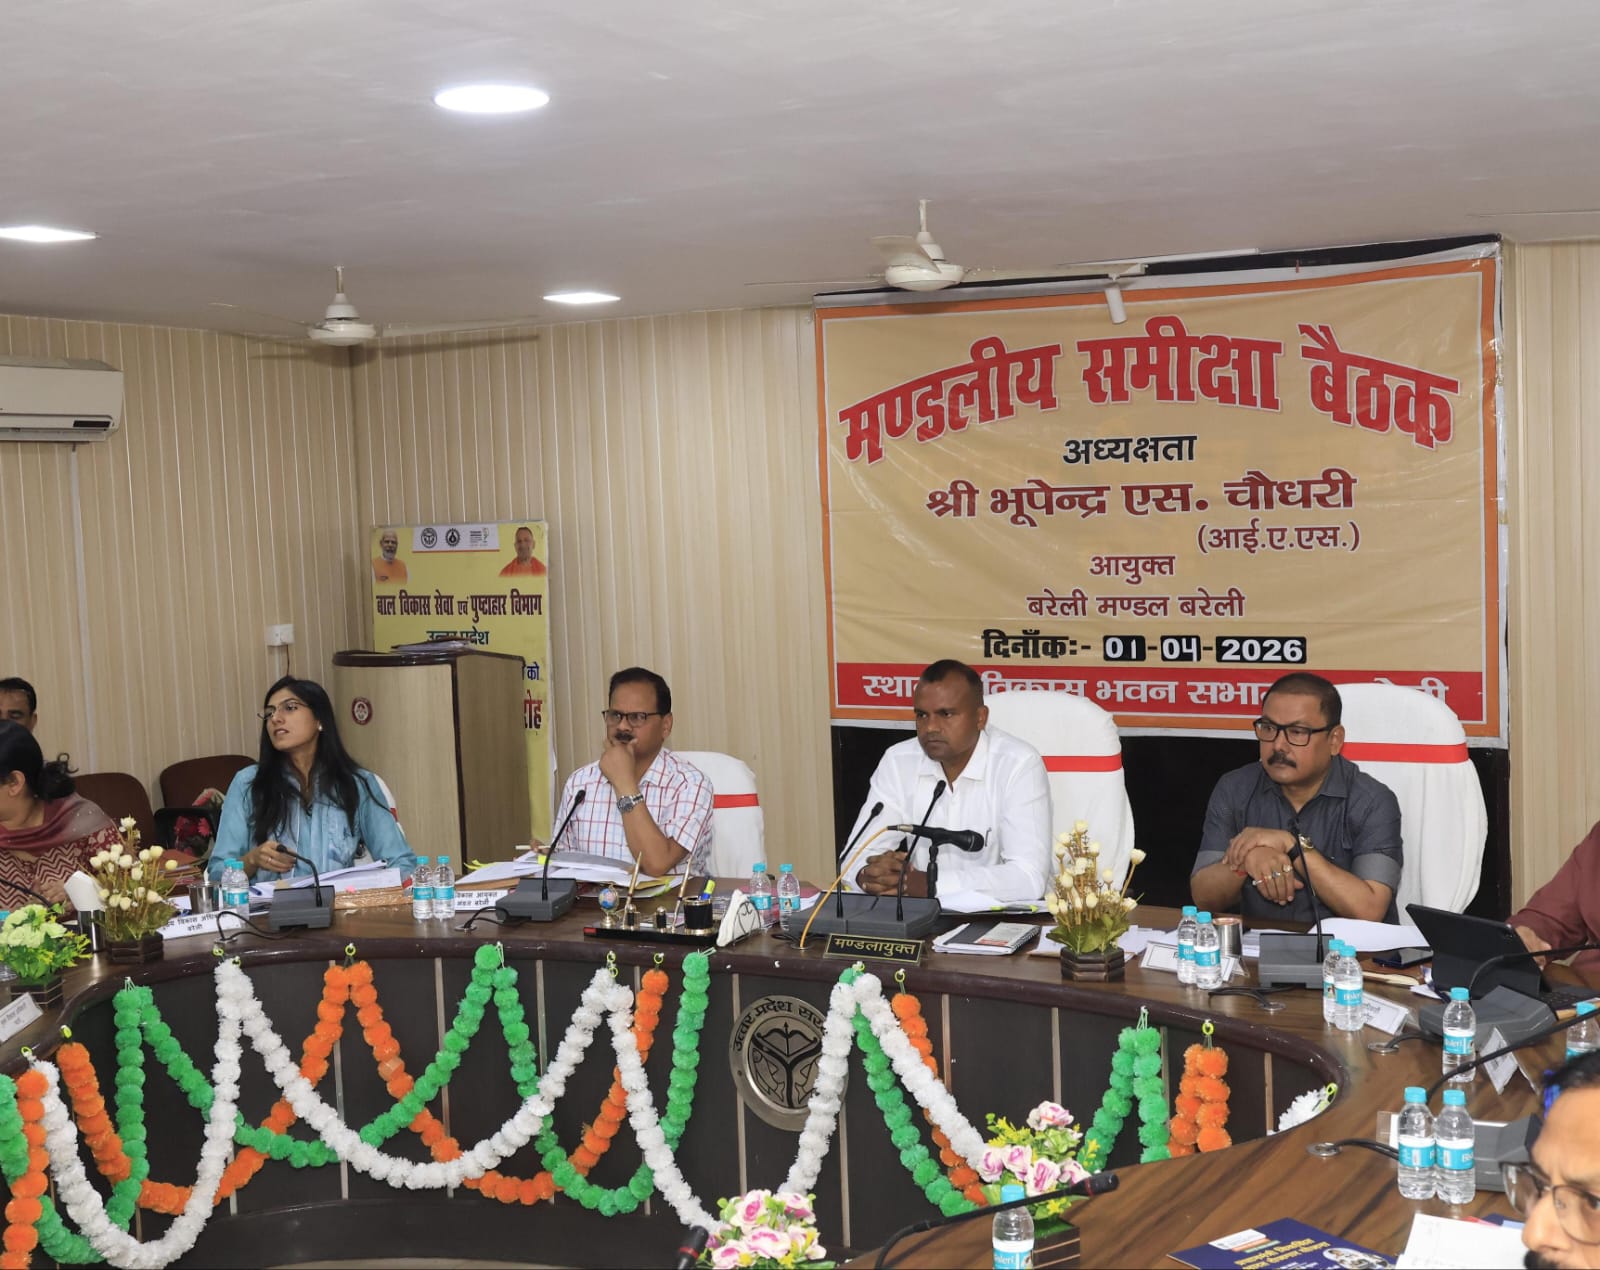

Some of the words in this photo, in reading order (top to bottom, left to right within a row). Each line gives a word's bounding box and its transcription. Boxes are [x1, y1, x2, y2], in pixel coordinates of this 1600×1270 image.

[838, 336, 1062, 465] मण्डलीय
[1076, 315, 1283, 411] समीक्षा
[1297, 323, 1459, 449] बैठक
[1062, 435, 1197, 464] अध्यक्षता
[926, 479, 980, 518] श्री
[990, 479, 1111, 528] भूपेन्द्र
[1121, 483, 1209, 515] एस.
[1223, 468, 1357, 510] चौधरी
[1198, 518, 1360, 553] (आई.ए.एस.)
[1089, 555, 1175, 584] आयुक्त
[376, 595, 396, 615] बाल
[399, 589, 431, 615] विकास
[434, 589, 454, 615] सेवा
[457, 596, 469, 615] एवं
[470, 595, 507, 623] पुष्टाहार
[510, 588, 542, 615] विभाग
[1026, 588, 1088, 616] बरेली
[1096, 596, 1170, 616] मण्डल
[1178, 587, 1245, 616] बरेली
[1096, 680, 1178, 703] भवन
[834, 938, 917, 957] मण्डलायुक्त
[733, 1013, 755, 1051] उत्तर
[754, 998, 793, 1016] प्रदेश
